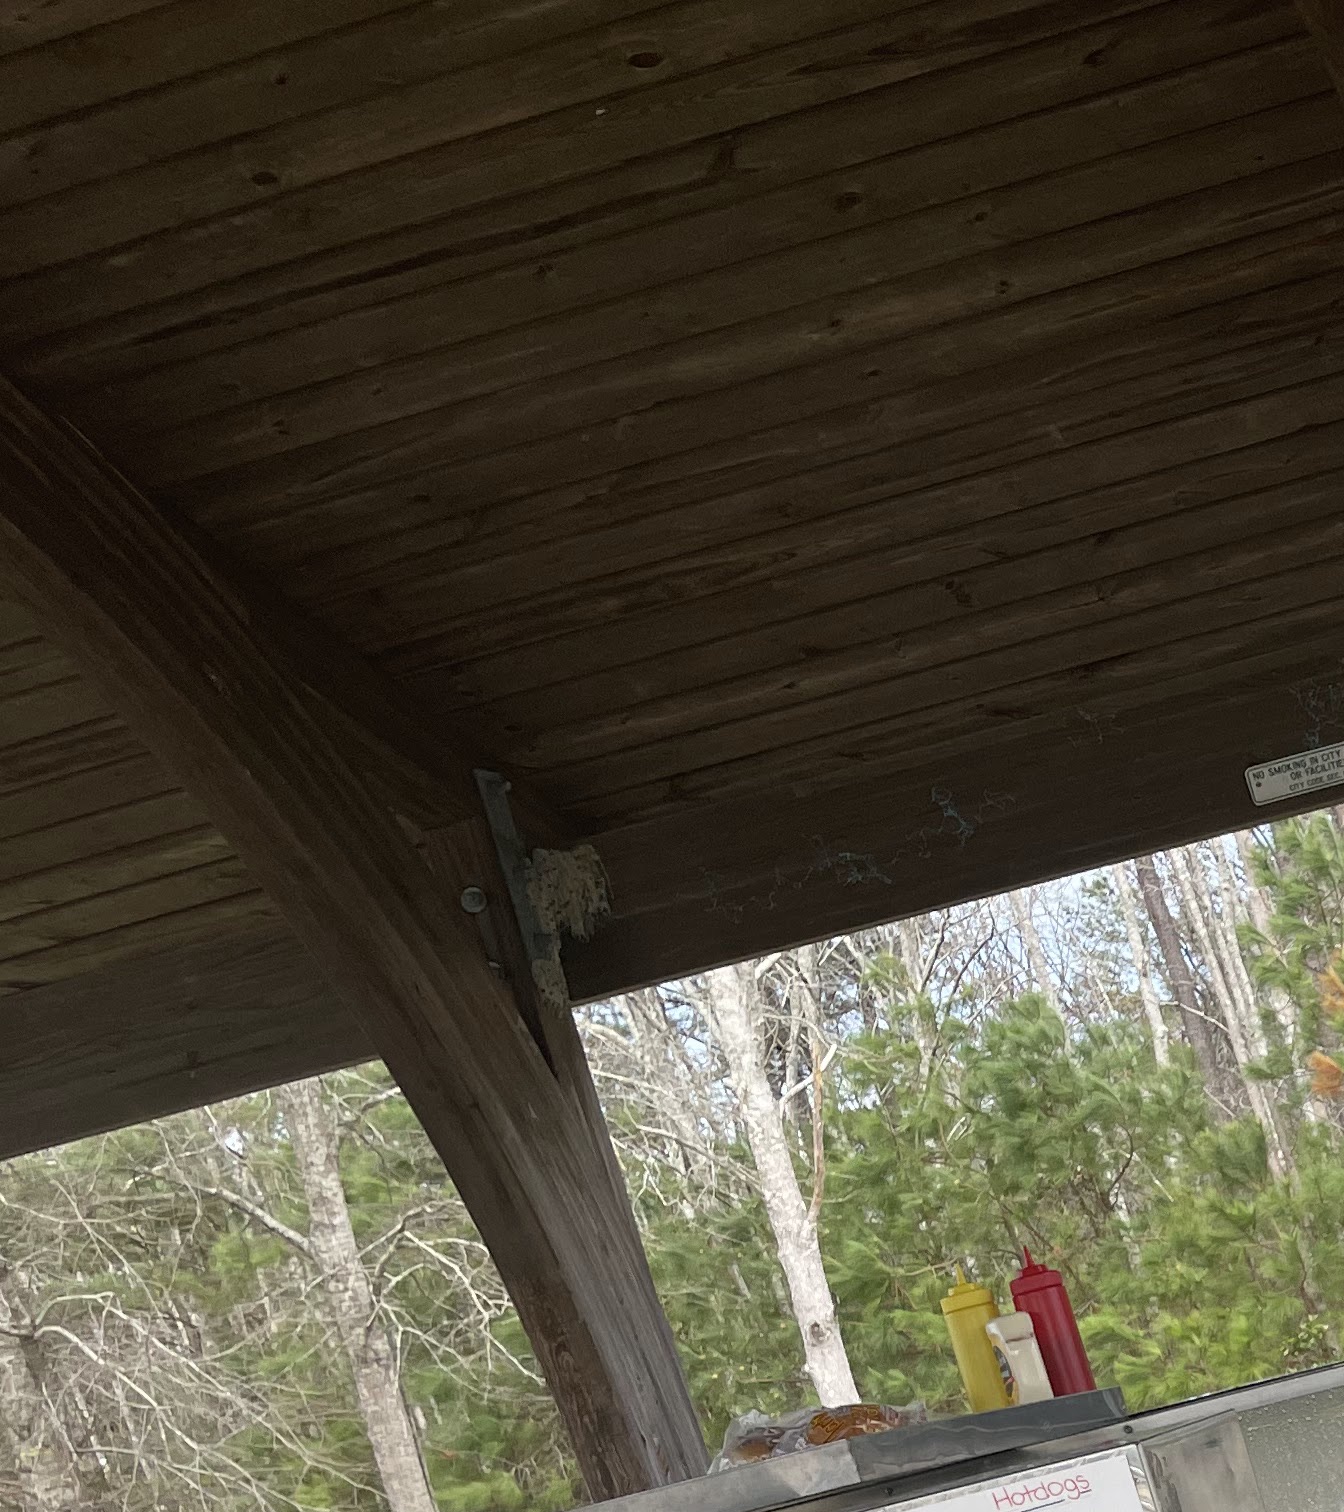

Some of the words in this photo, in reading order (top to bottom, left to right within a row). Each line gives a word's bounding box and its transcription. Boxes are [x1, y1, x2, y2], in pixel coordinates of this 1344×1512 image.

[1252, 769, 1265, 780] NO
[1268, 760, 1307, 777] SMOKING
[1309, 756, 1319, 765] IN
[1321, 750, 1341, 762] CITY
[1290, 771, 1303, 781] OR
[1289, 781, 1305, 792] CITY
[992, 1474, 1090, 1510] Hotdogs
